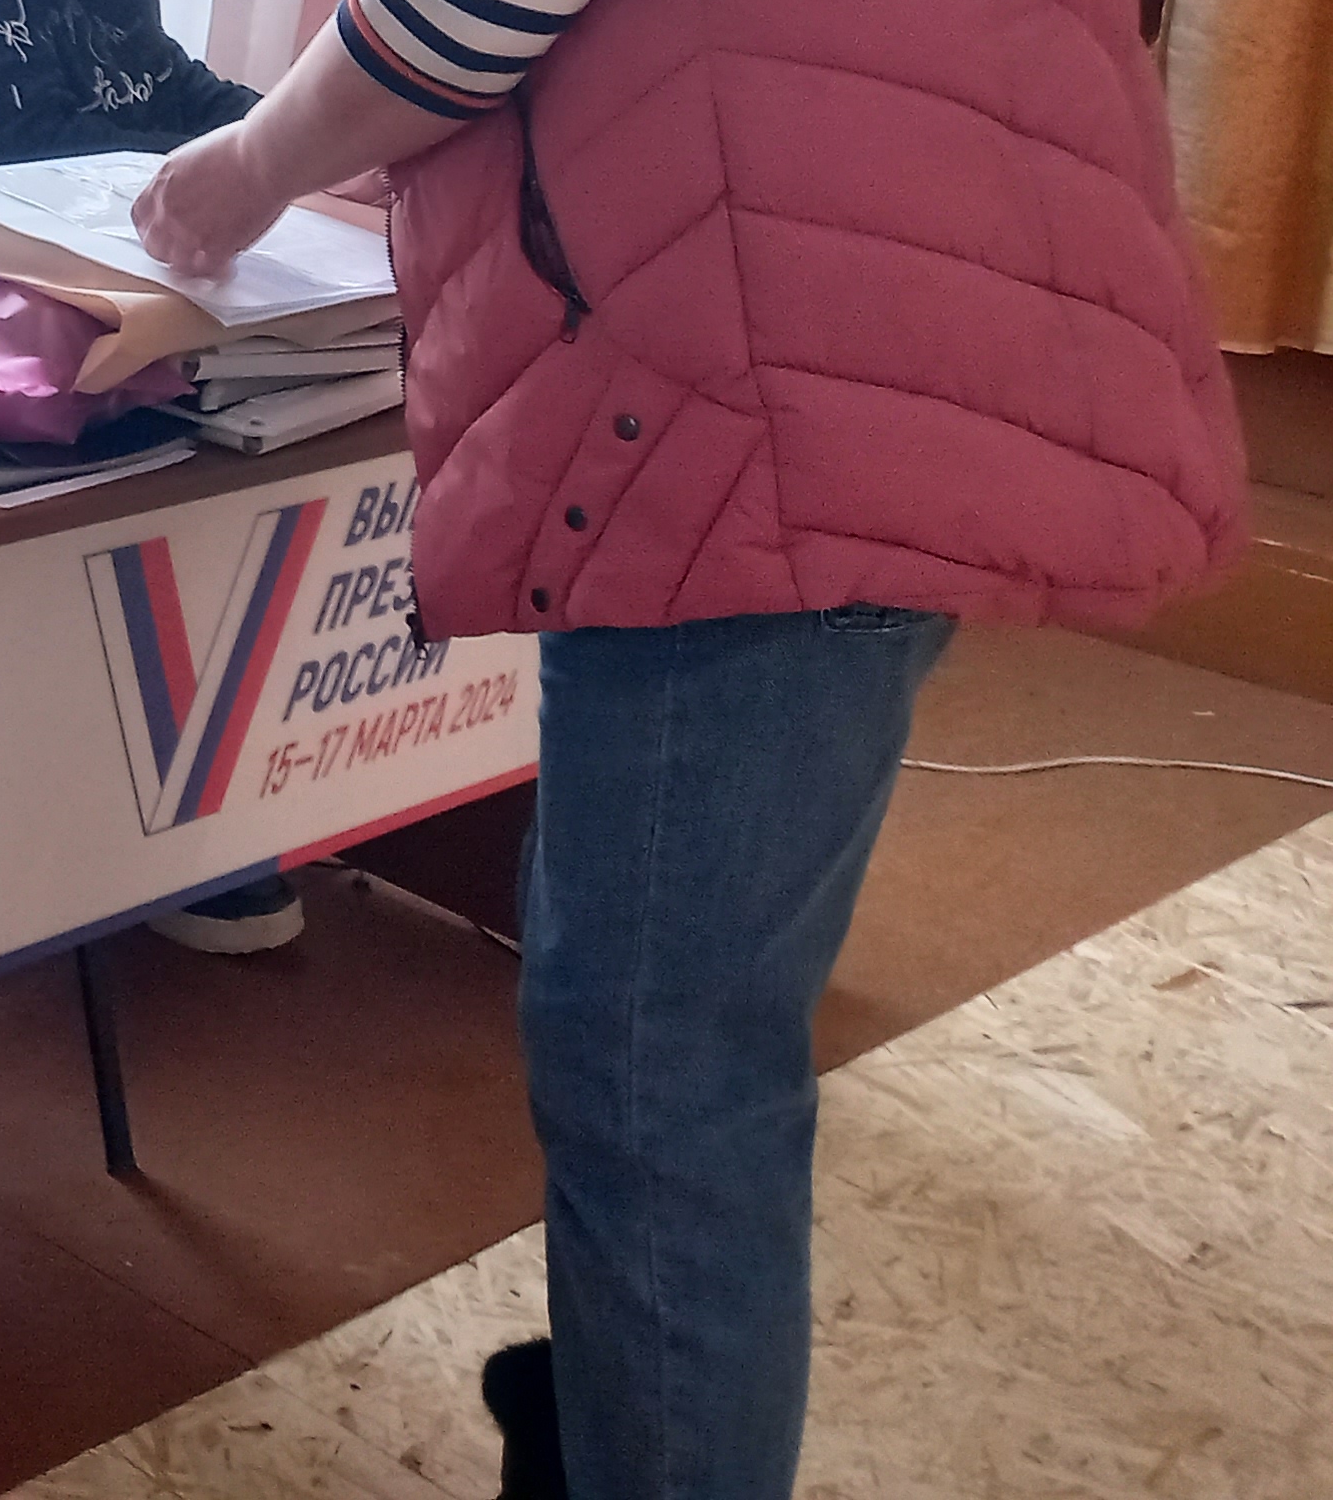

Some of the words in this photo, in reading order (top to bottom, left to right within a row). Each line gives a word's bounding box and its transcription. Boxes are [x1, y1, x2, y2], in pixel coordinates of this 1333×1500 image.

[344, 476, 419, 547] ВЫ
[345, 694, 449, 771] МАРТА
[447, 668, 519, 736] 2024
